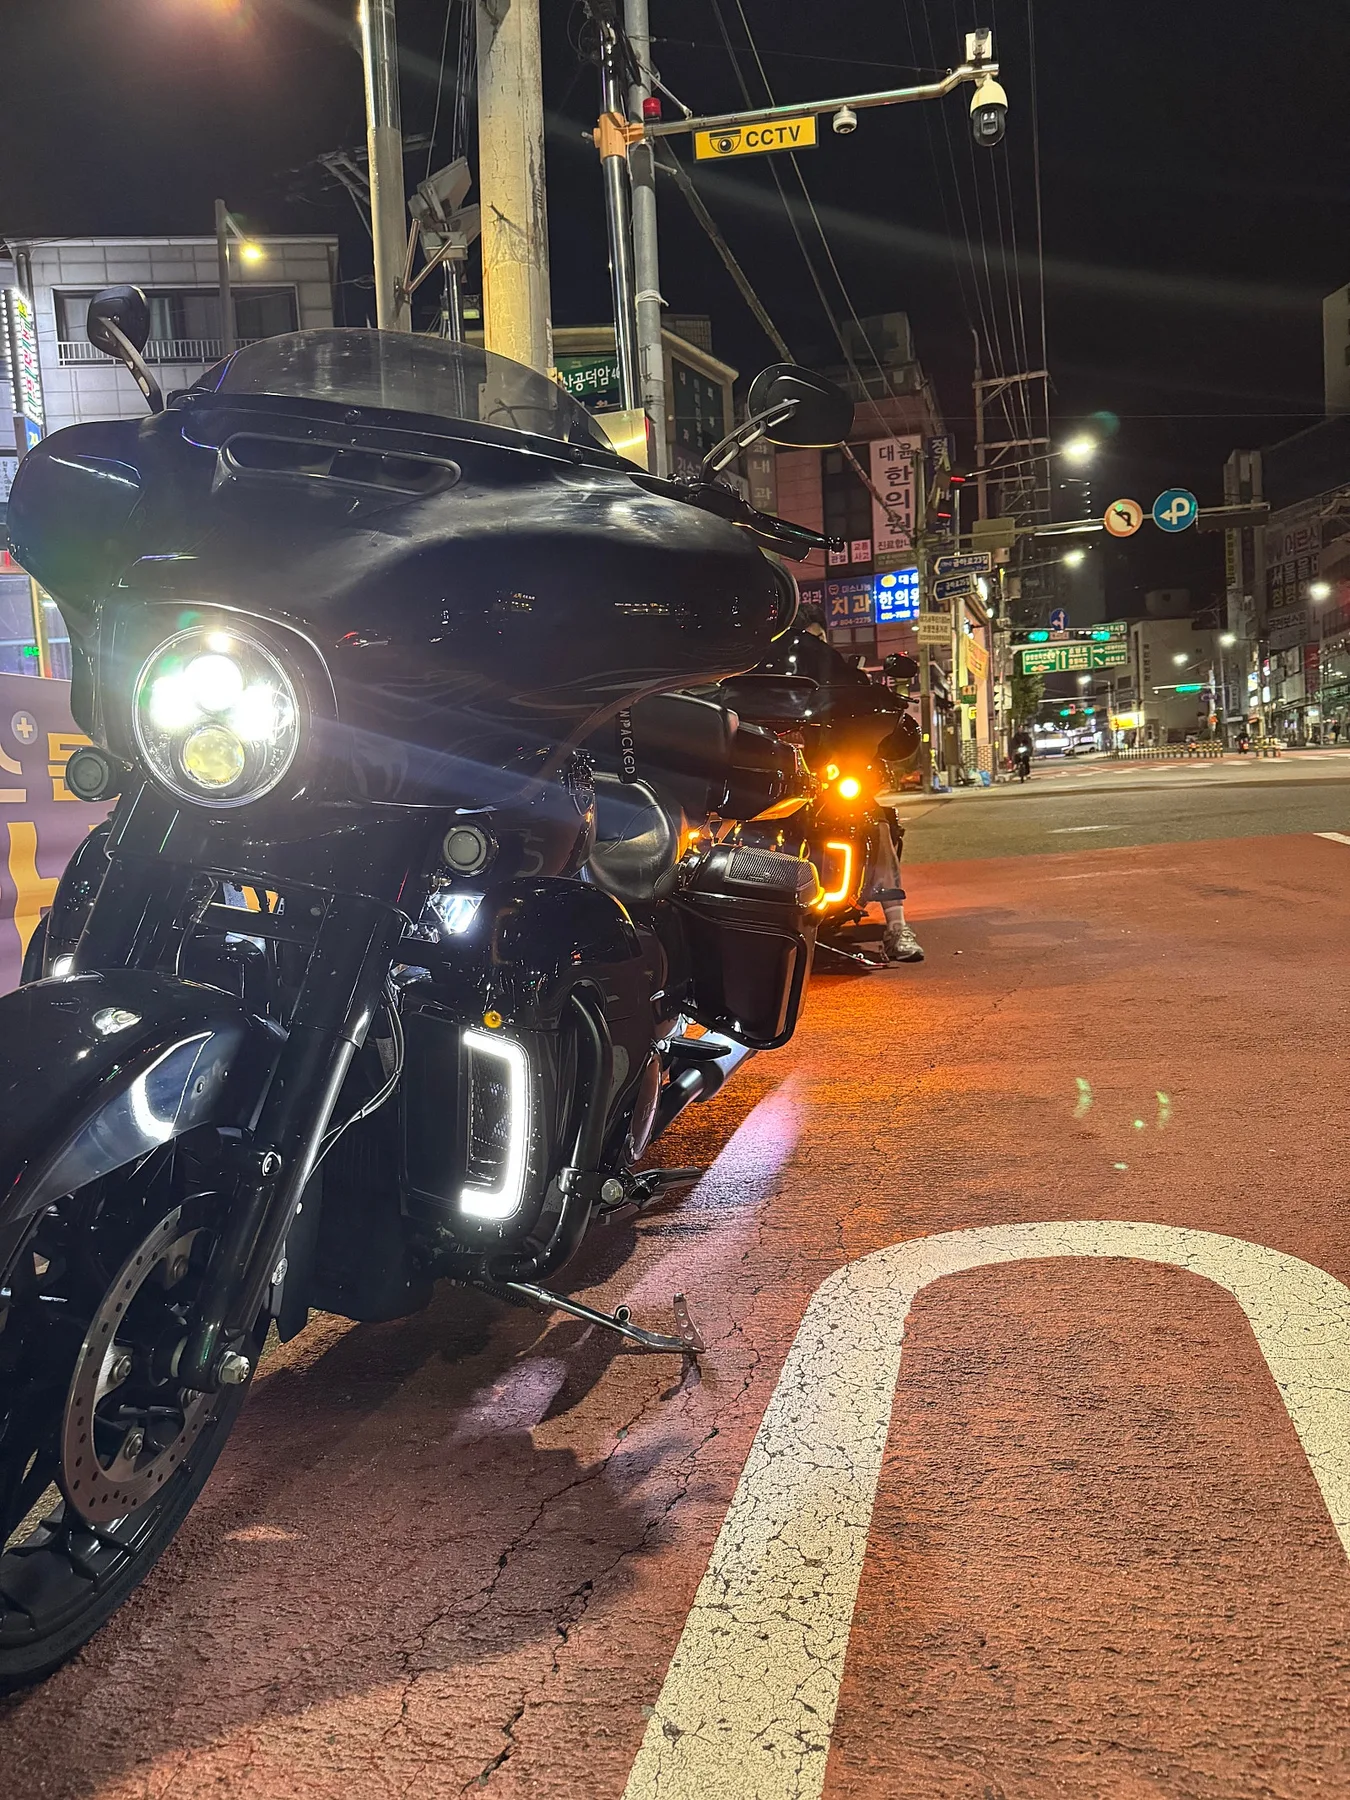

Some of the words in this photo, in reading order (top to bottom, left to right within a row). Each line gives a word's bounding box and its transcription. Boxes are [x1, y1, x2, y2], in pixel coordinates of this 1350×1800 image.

[745, 125, 801, 147] CCTV
[563, 365, 611, 393] 산공덕암
[879, 443, 914, 461] 대윤
[831, 593, 871, 616] 치과
